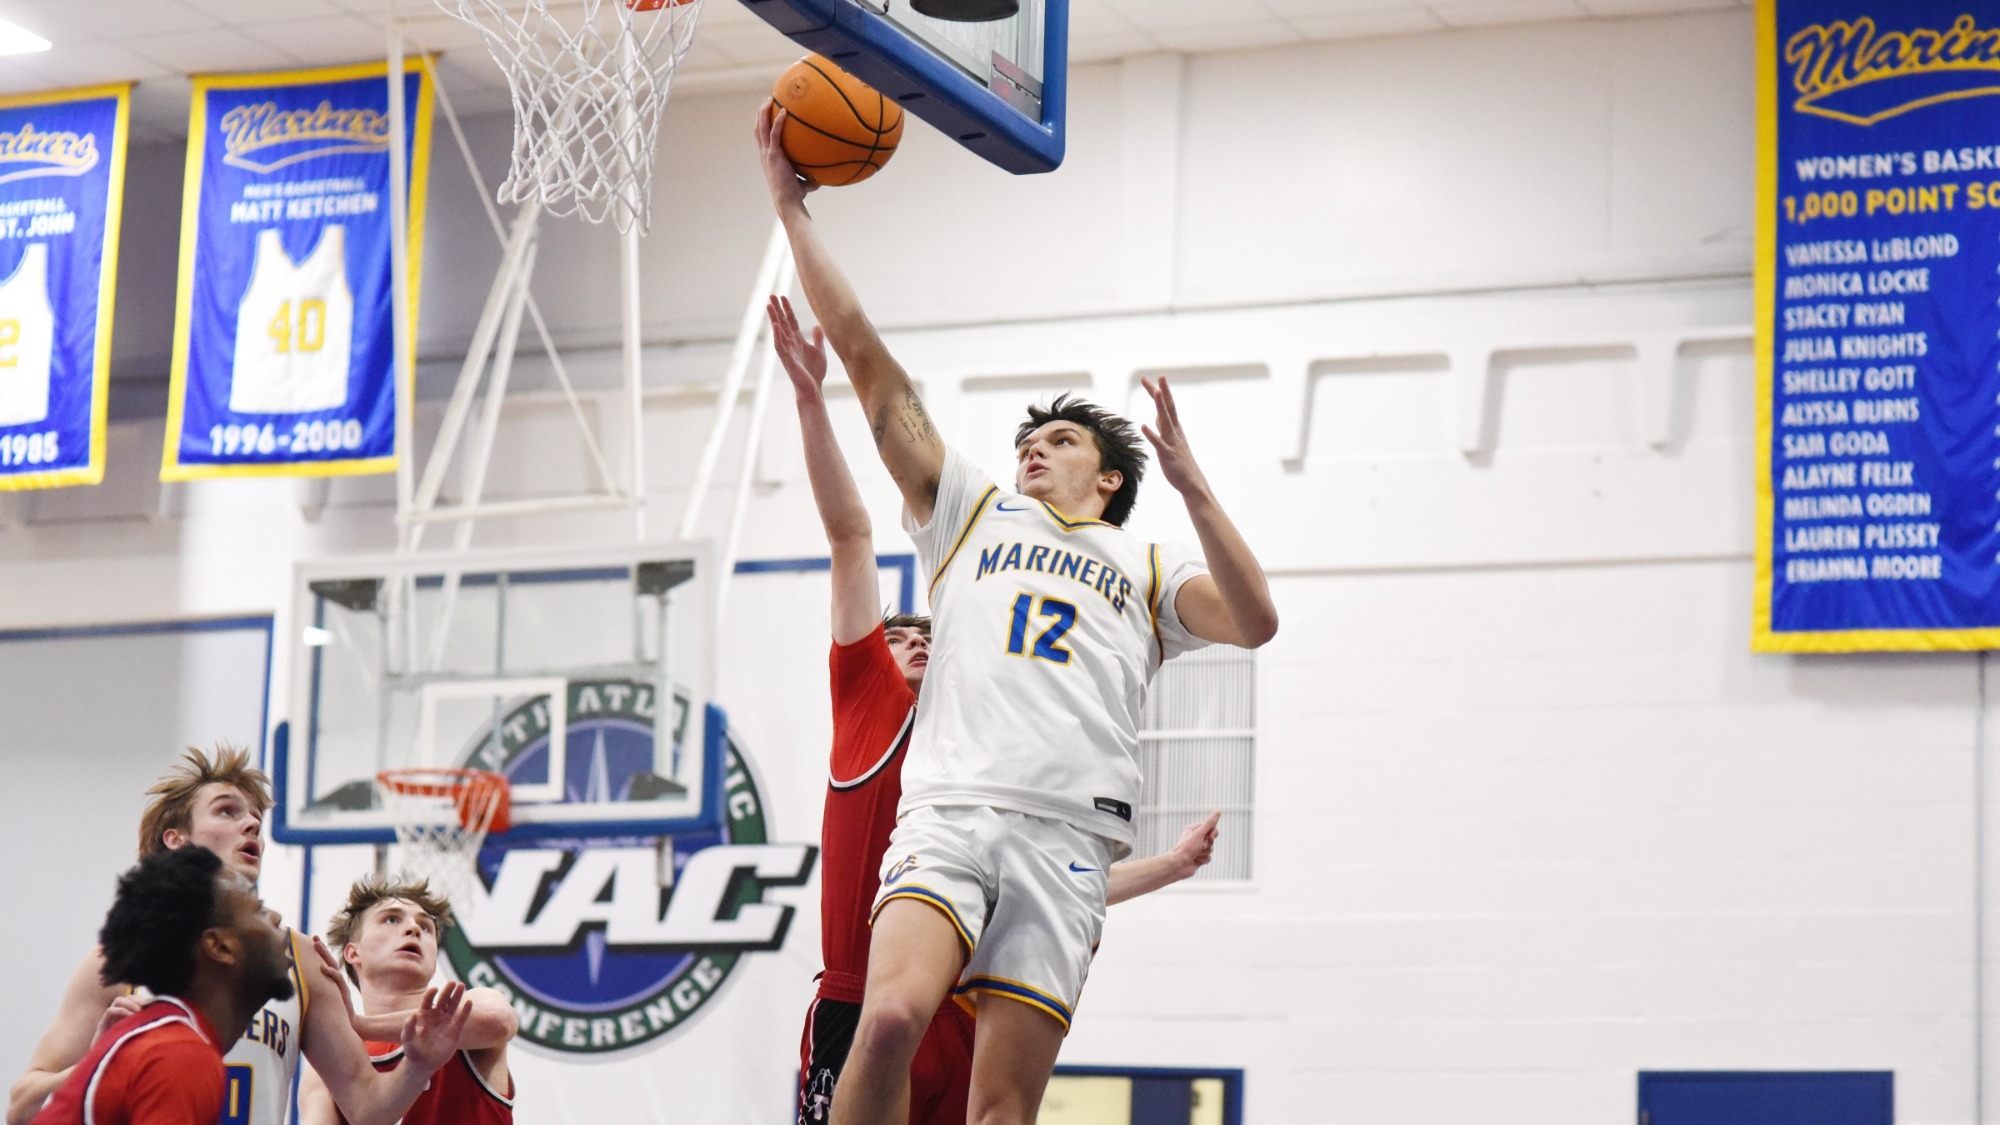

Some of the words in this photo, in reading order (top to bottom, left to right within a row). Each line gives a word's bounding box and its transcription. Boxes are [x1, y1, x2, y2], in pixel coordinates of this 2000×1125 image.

[1796, 152, 1917, 181] WOMEN'S
[230, 201, 283, 224] MATT
[286, 192, 378, 220] KETCHEN
[1784, 190, 1858, 224] 1,000
[1865, 183, 1960, 216] POINT
[25, 211, 76, 237] JOHN
[1785, 240, 1868, 267] VANESSA
[1784, 272, 1864, 300] MONICA
[1868, 267, 1930, 295] LOCKE
[267, 298, 327, 353] 40
[1784, 303, 1851, 331] STACEY
[1854, 301, 1905, 327] RYAN
[1783, 335, 1837, 363] JULIA
[1840, 332, 1928, 359] KNIGHTS
[1783, 367, 1861, 395] SHELLEY
[1864, 365, 1916, 391] GOTT
[1782, 400, 1849, 426] ALYSSA
[1853, 397, 1920, 424] BURNS
[0, 429, 59, 467] 1985
[209, 417, 363, 456] 1996-2000
[1783, 432, 1826, 459] SAM
[1829, 430, 1890, 457] GODA
[1782, 462, 1857, 490] ALAYNE
[1861, 461, 1914, 487] FELIX
[1784, 494, 1863, 521] MELINDA
[1866, 493, 1932, 517] OGDEN
[1785, 525, 1860, 553] LAUREN
[1865, 523, 1941, 549] PLISSEY
[975, 542, 1132, 616] MARINERS
[1871, 555, 1942, 580] MOORE
[1005, 591, 1079, 667] 12
